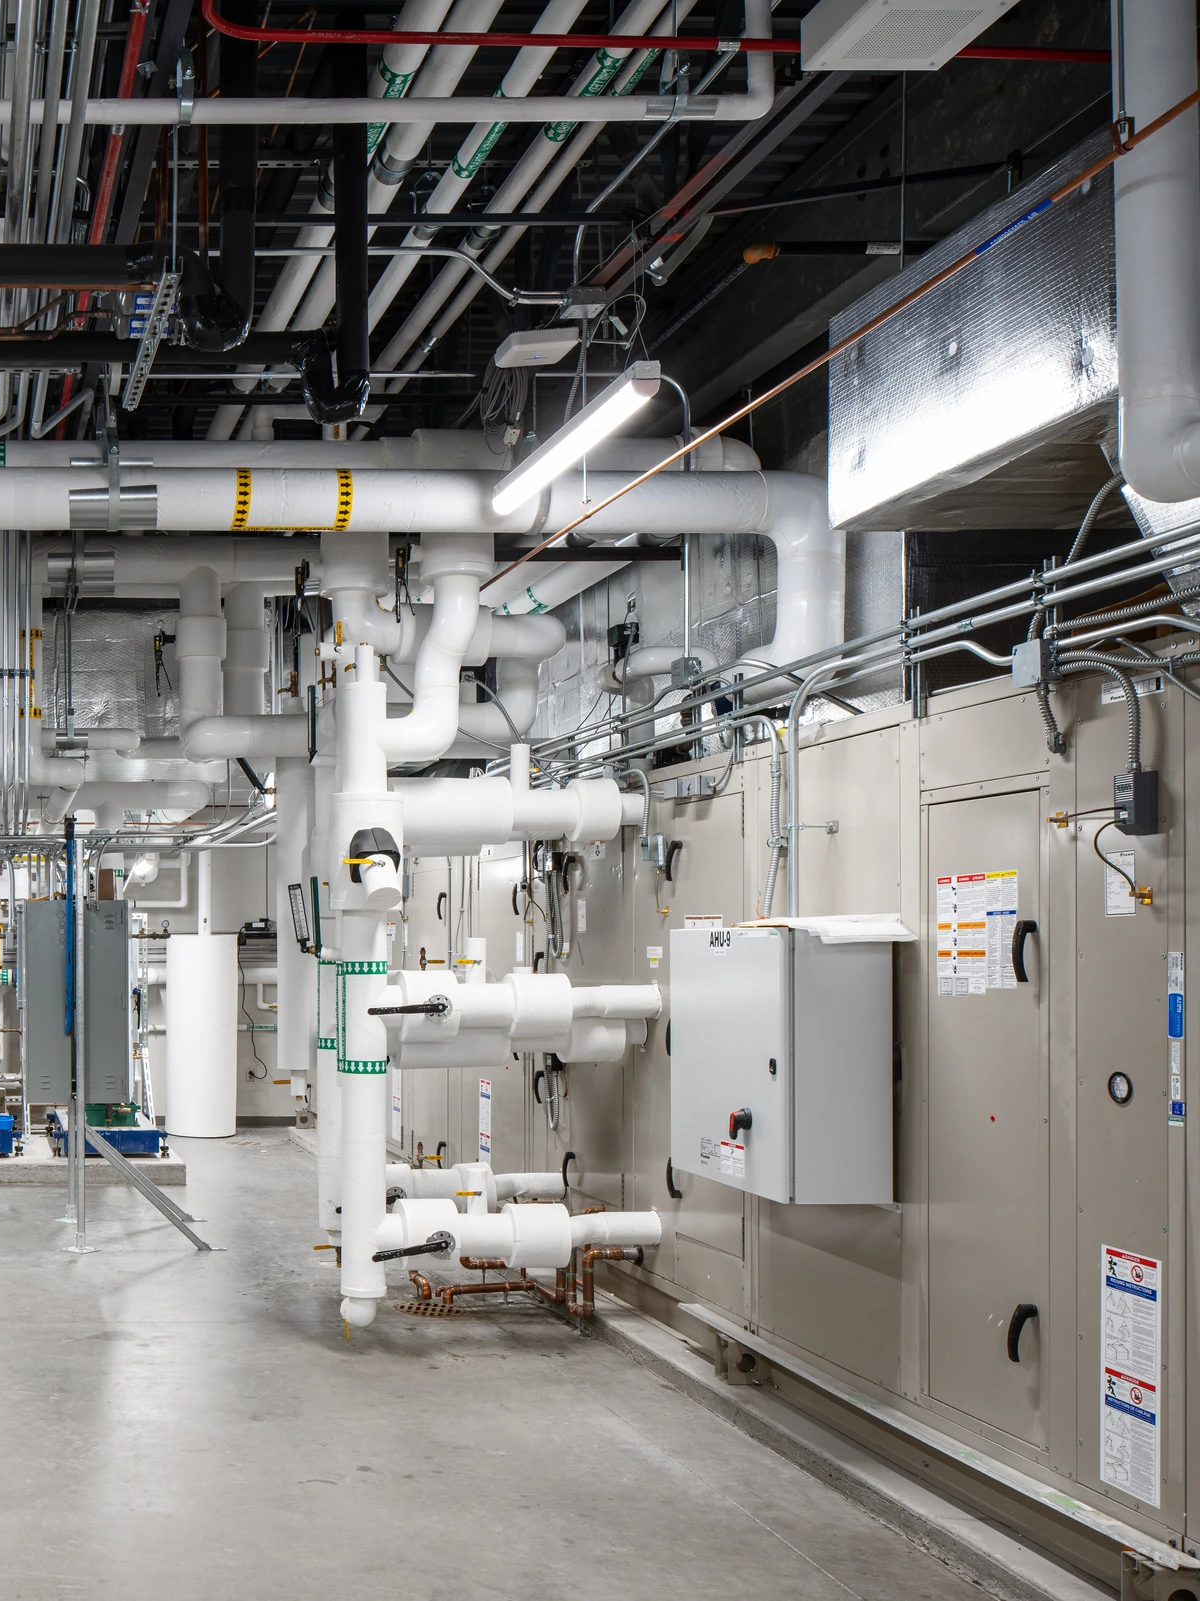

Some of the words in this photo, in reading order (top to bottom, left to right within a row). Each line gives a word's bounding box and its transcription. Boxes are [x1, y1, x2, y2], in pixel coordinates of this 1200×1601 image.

[587, 66, 615, 94] CHILLED
[709, 931, 731, 947] AHU-9
[1126, 1255, 1140, 1263] DANGER
[1125, 1281, 1153, 1294] INSTRUCTIONS
[1125, 1376, 1140, 1384] DANGER
